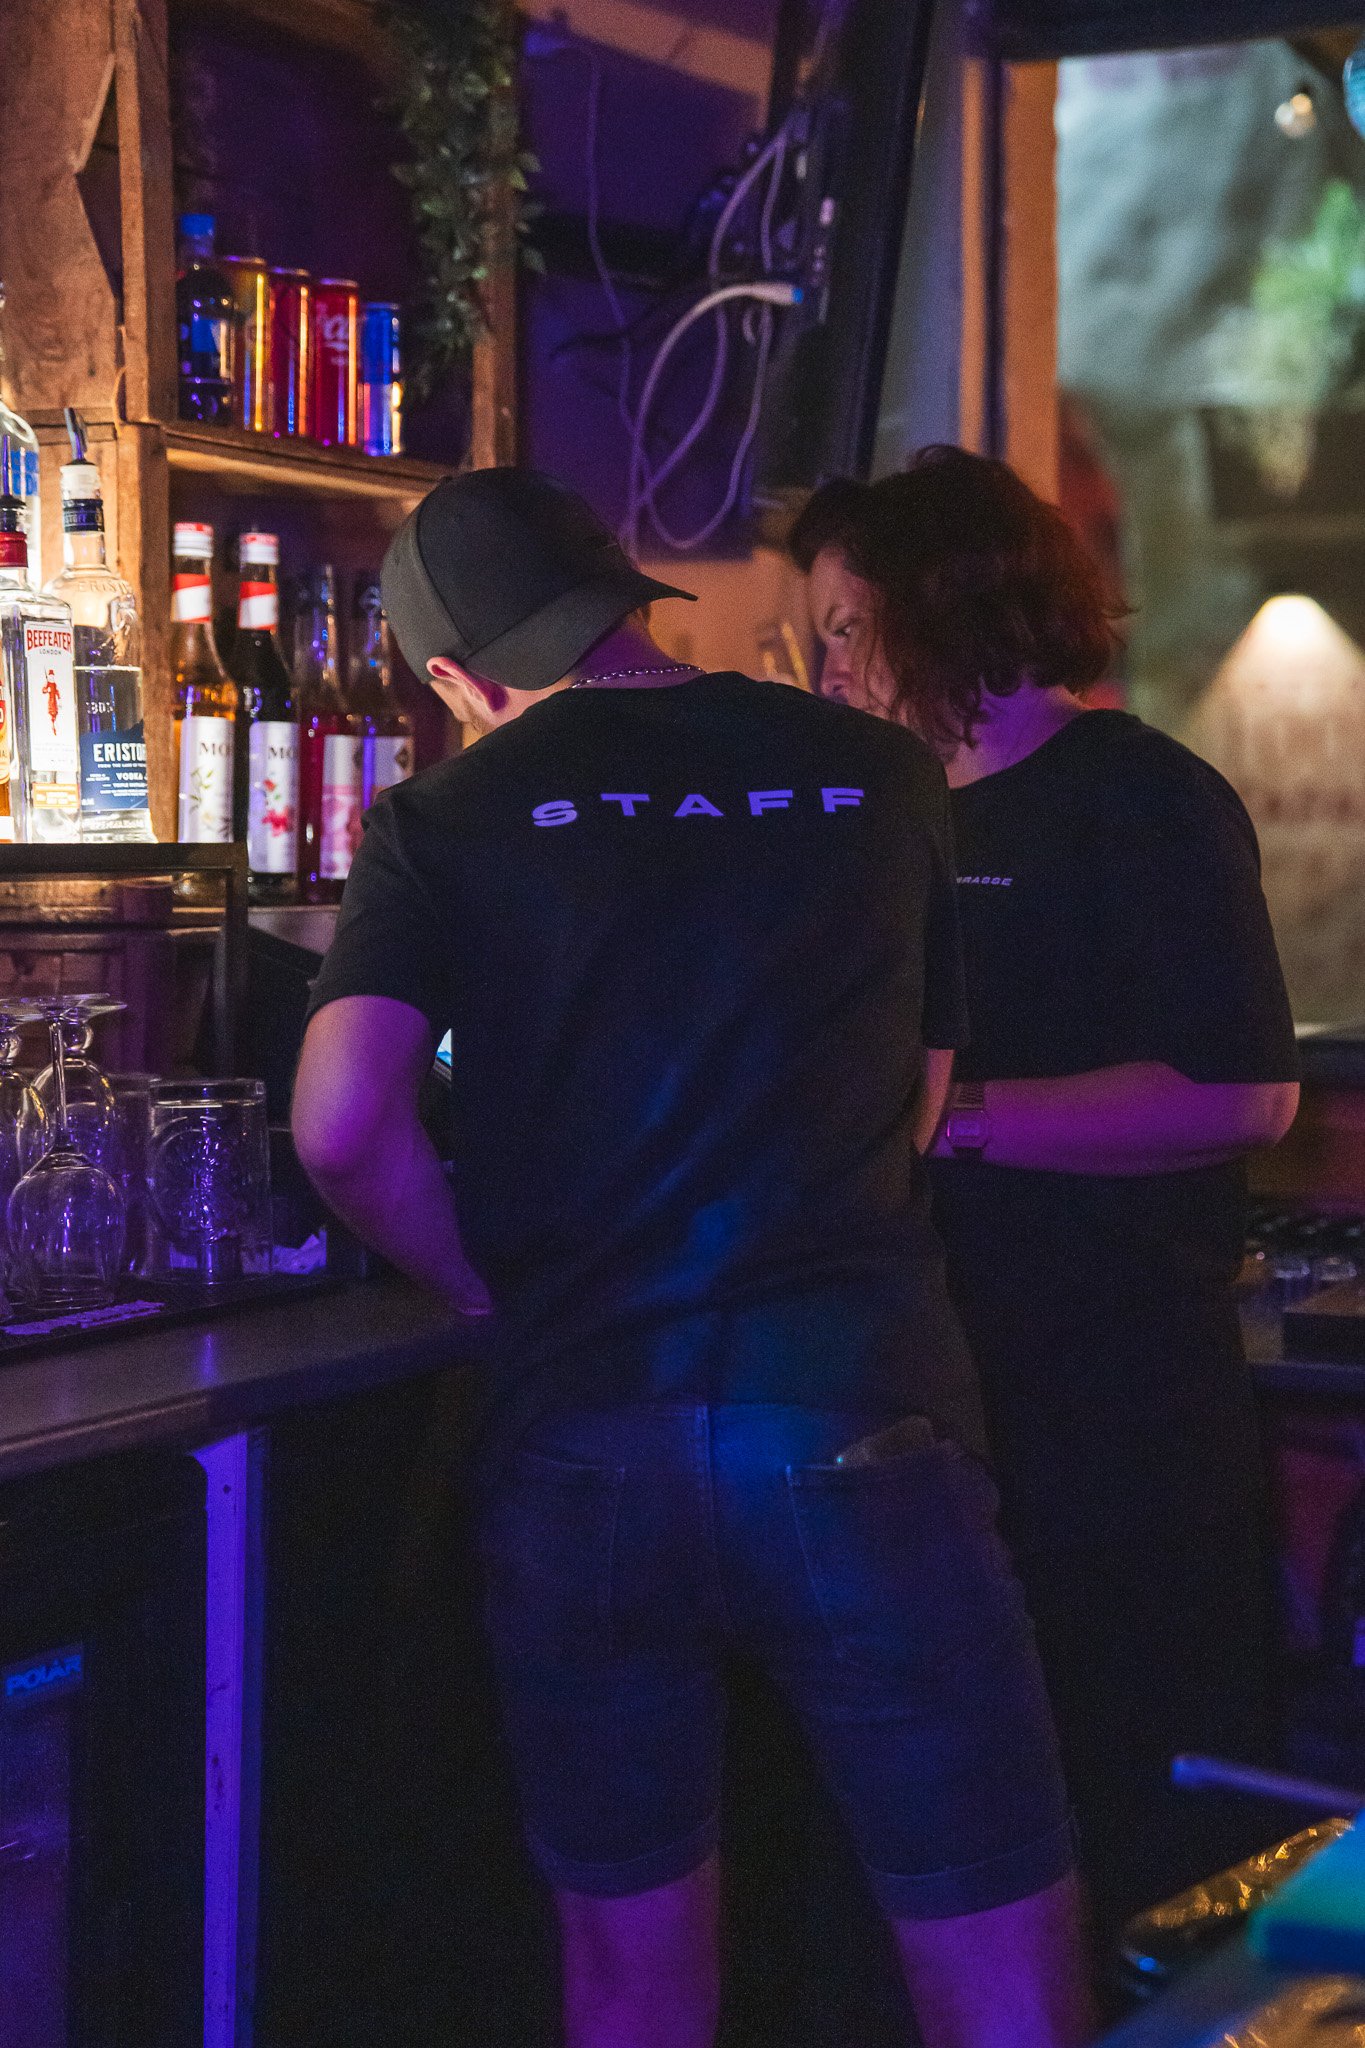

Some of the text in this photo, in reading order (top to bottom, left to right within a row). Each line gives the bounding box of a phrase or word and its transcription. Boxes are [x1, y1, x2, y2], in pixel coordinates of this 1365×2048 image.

[26, 629, 72, 653] BEEFEATER
[531, 787, 865, 827] STAFF
[6, 1654, 81, 1697] POLAR
